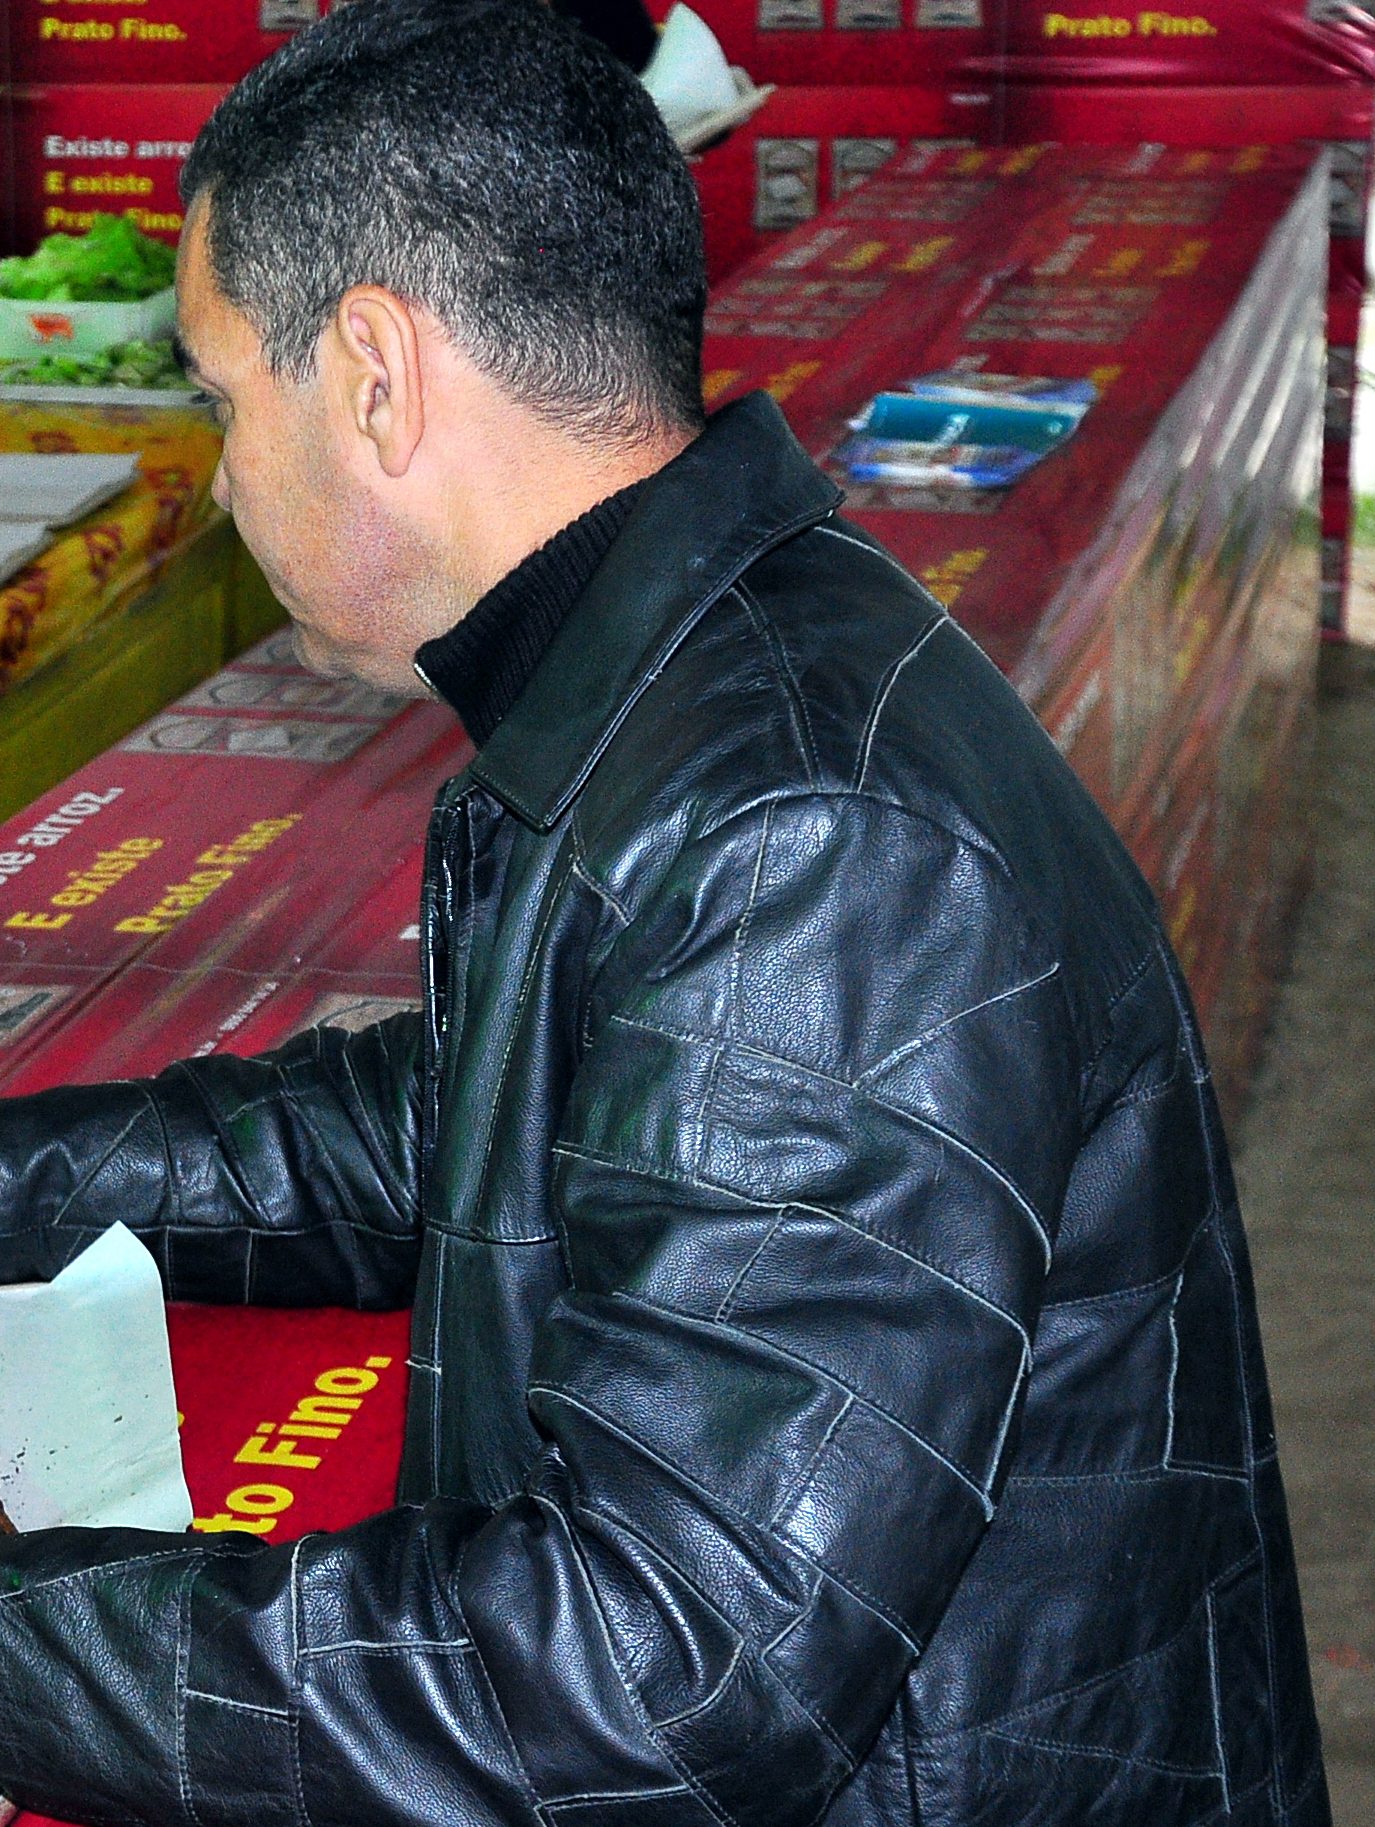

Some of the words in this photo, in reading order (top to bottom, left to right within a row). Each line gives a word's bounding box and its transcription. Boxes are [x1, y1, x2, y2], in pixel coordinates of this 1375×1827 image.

[41, 18, 115, 40] Prato
[1045, 13, 1132, 37] Prato
[43, 135, 129, 158] Existe
[44, 171, 65, 194] E
[71, 173, 154, 194] existe
[45, 206, 94, 230] Pra
[4, 911, 73, 929] E
[51, 837, 164, 907] existe
[114, 869, 234, 933] Prato
[233, 1356, 392, 1470] Fino.
